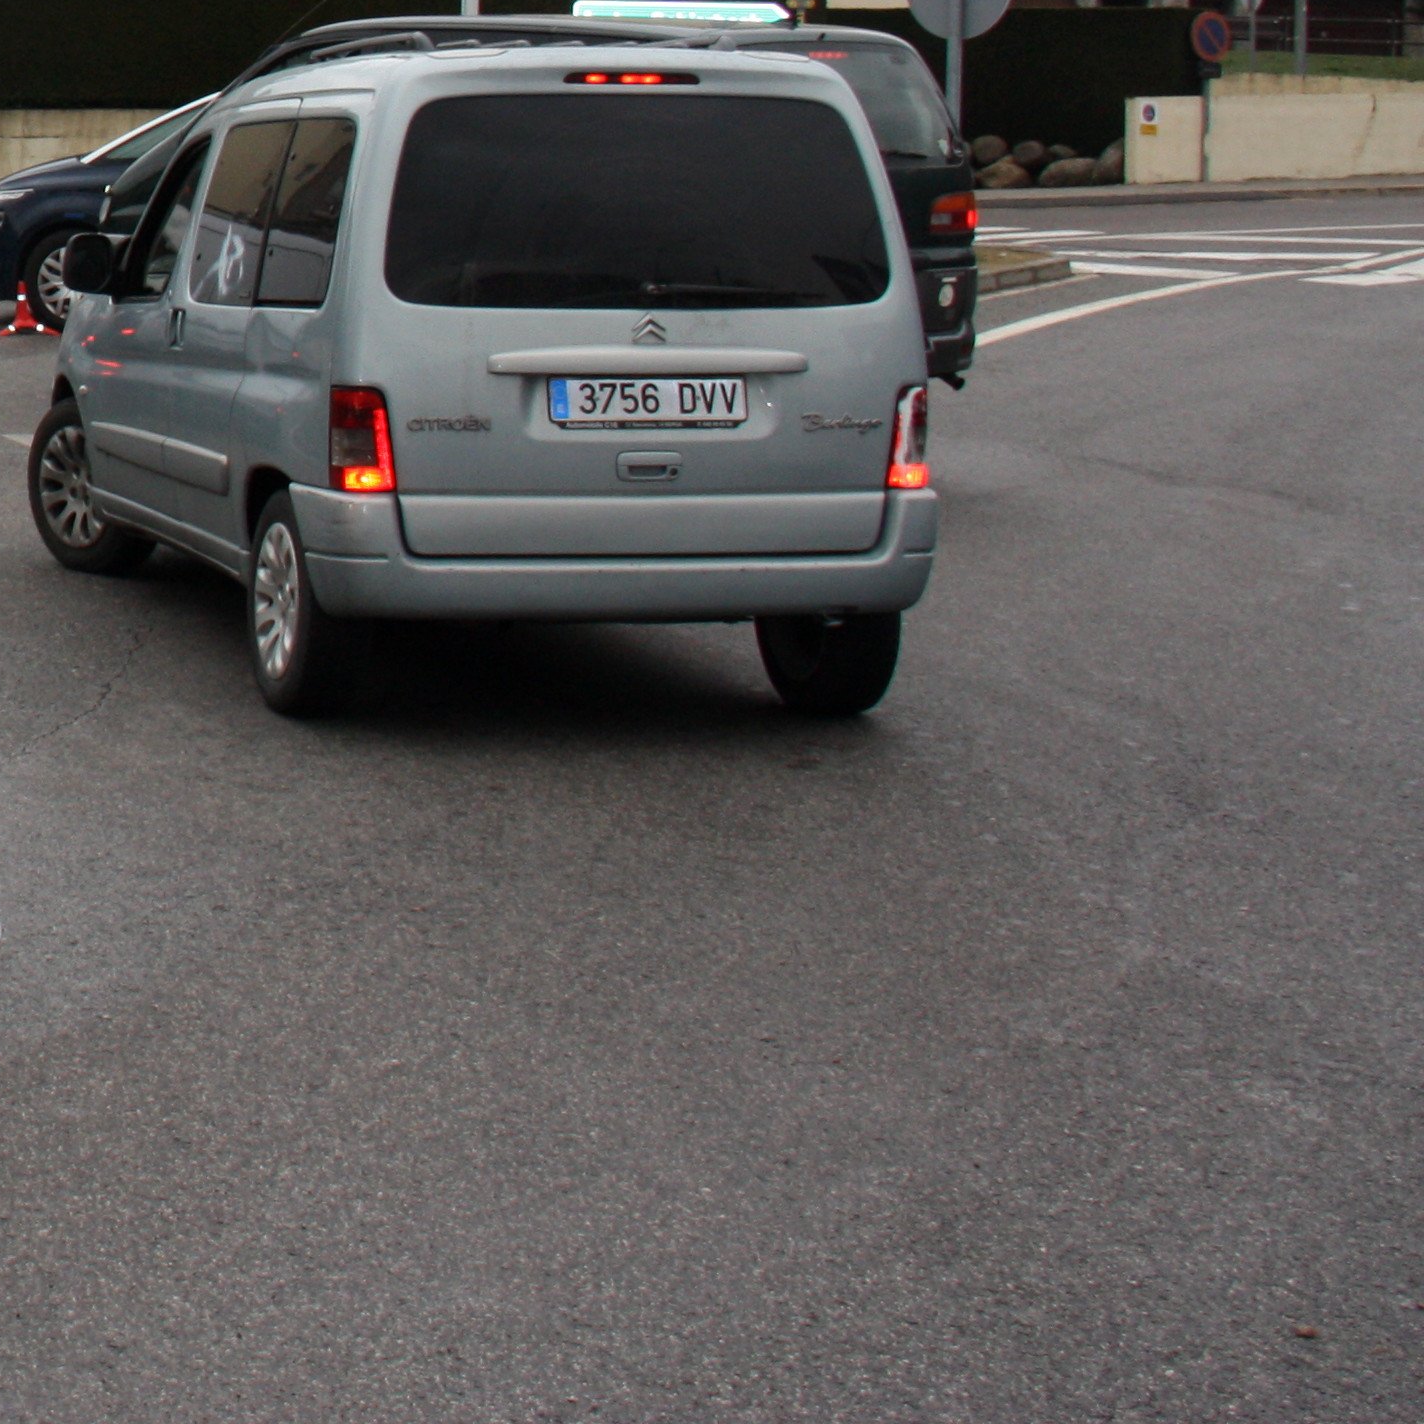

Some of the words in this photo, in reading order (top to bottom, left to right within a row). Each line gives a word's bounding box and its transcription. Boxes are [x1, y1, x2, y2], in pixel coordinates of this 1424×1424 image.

[578, 382, 660, 415] 3756
[678, 382, 737, 415] DVV
[406, 415, 492, 432] CITROËN
